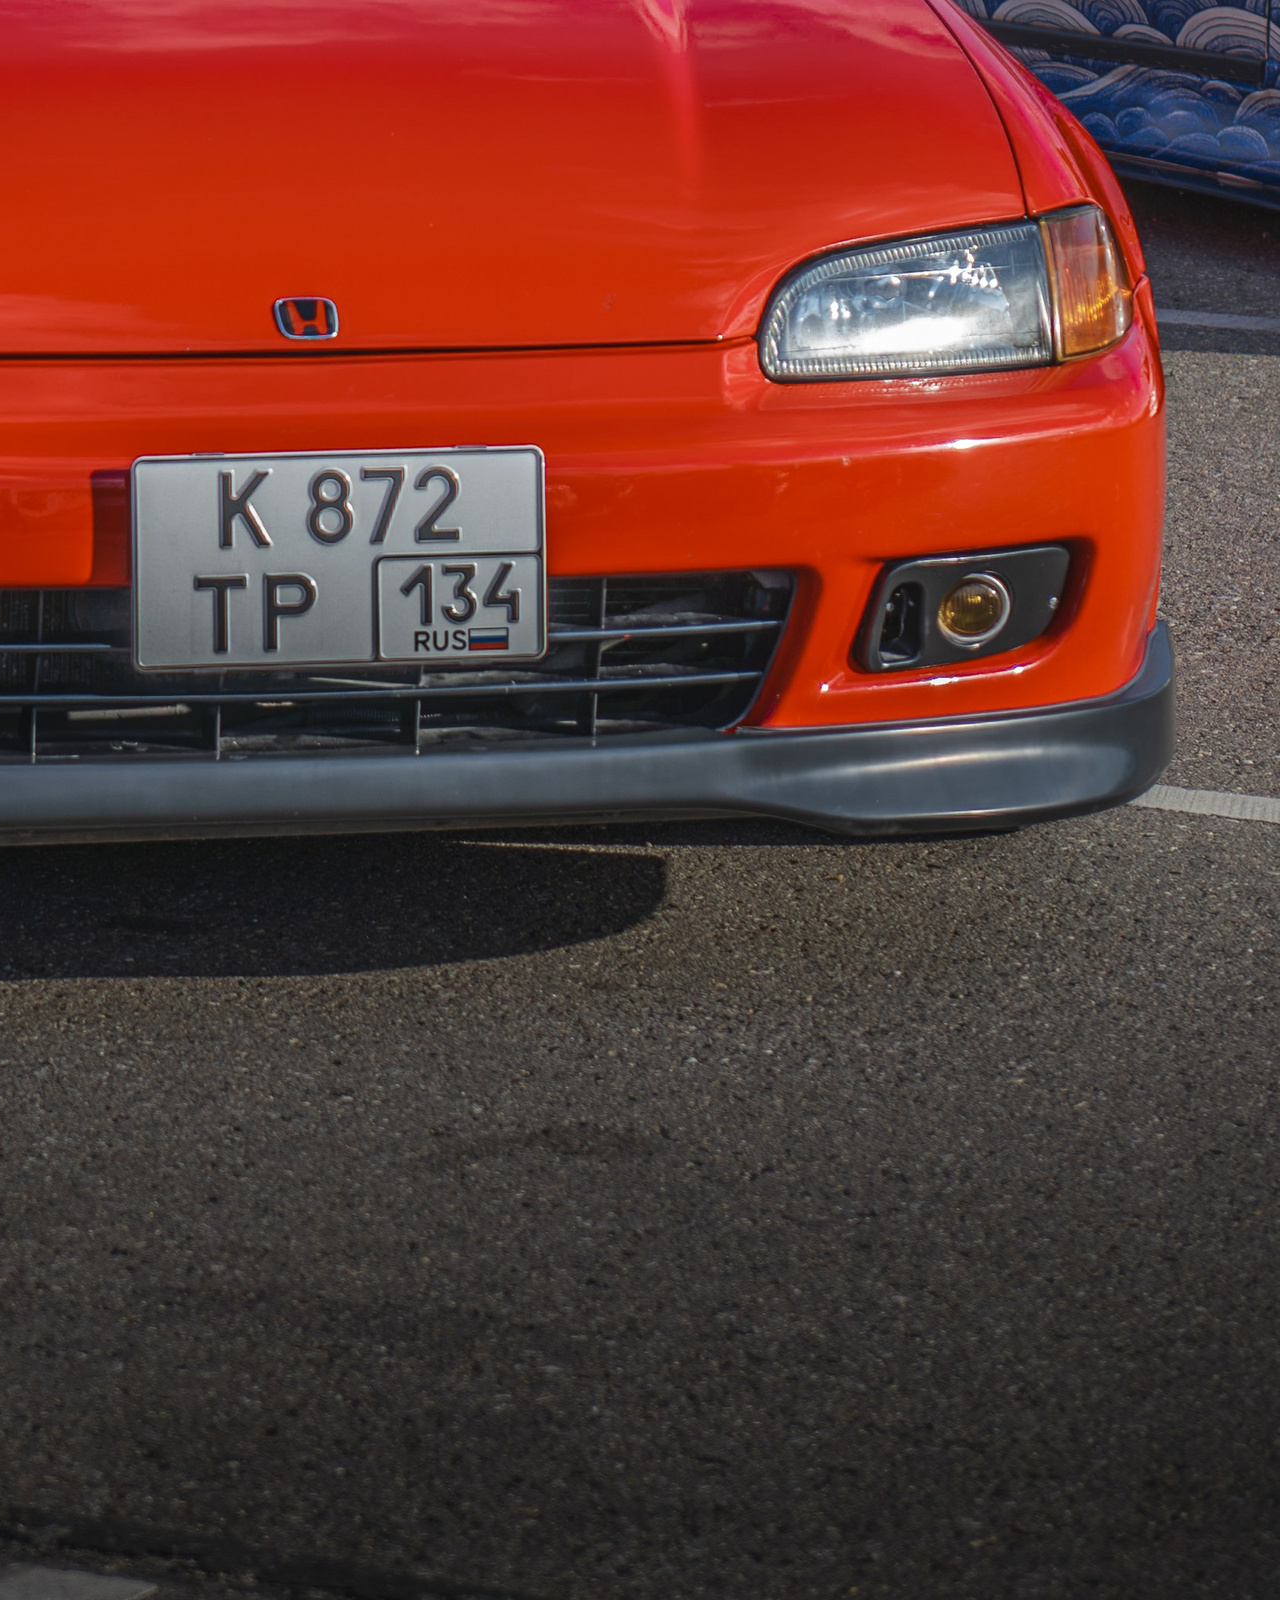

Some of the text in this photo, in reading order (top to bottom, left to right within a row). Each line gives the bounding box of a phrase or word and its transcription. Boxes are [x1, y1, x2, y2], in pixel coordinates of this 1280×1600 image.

[306, 464, 462, 546] 872
[400, 561, 521, 626] 134
[414, 629, 467, 653] RUS
